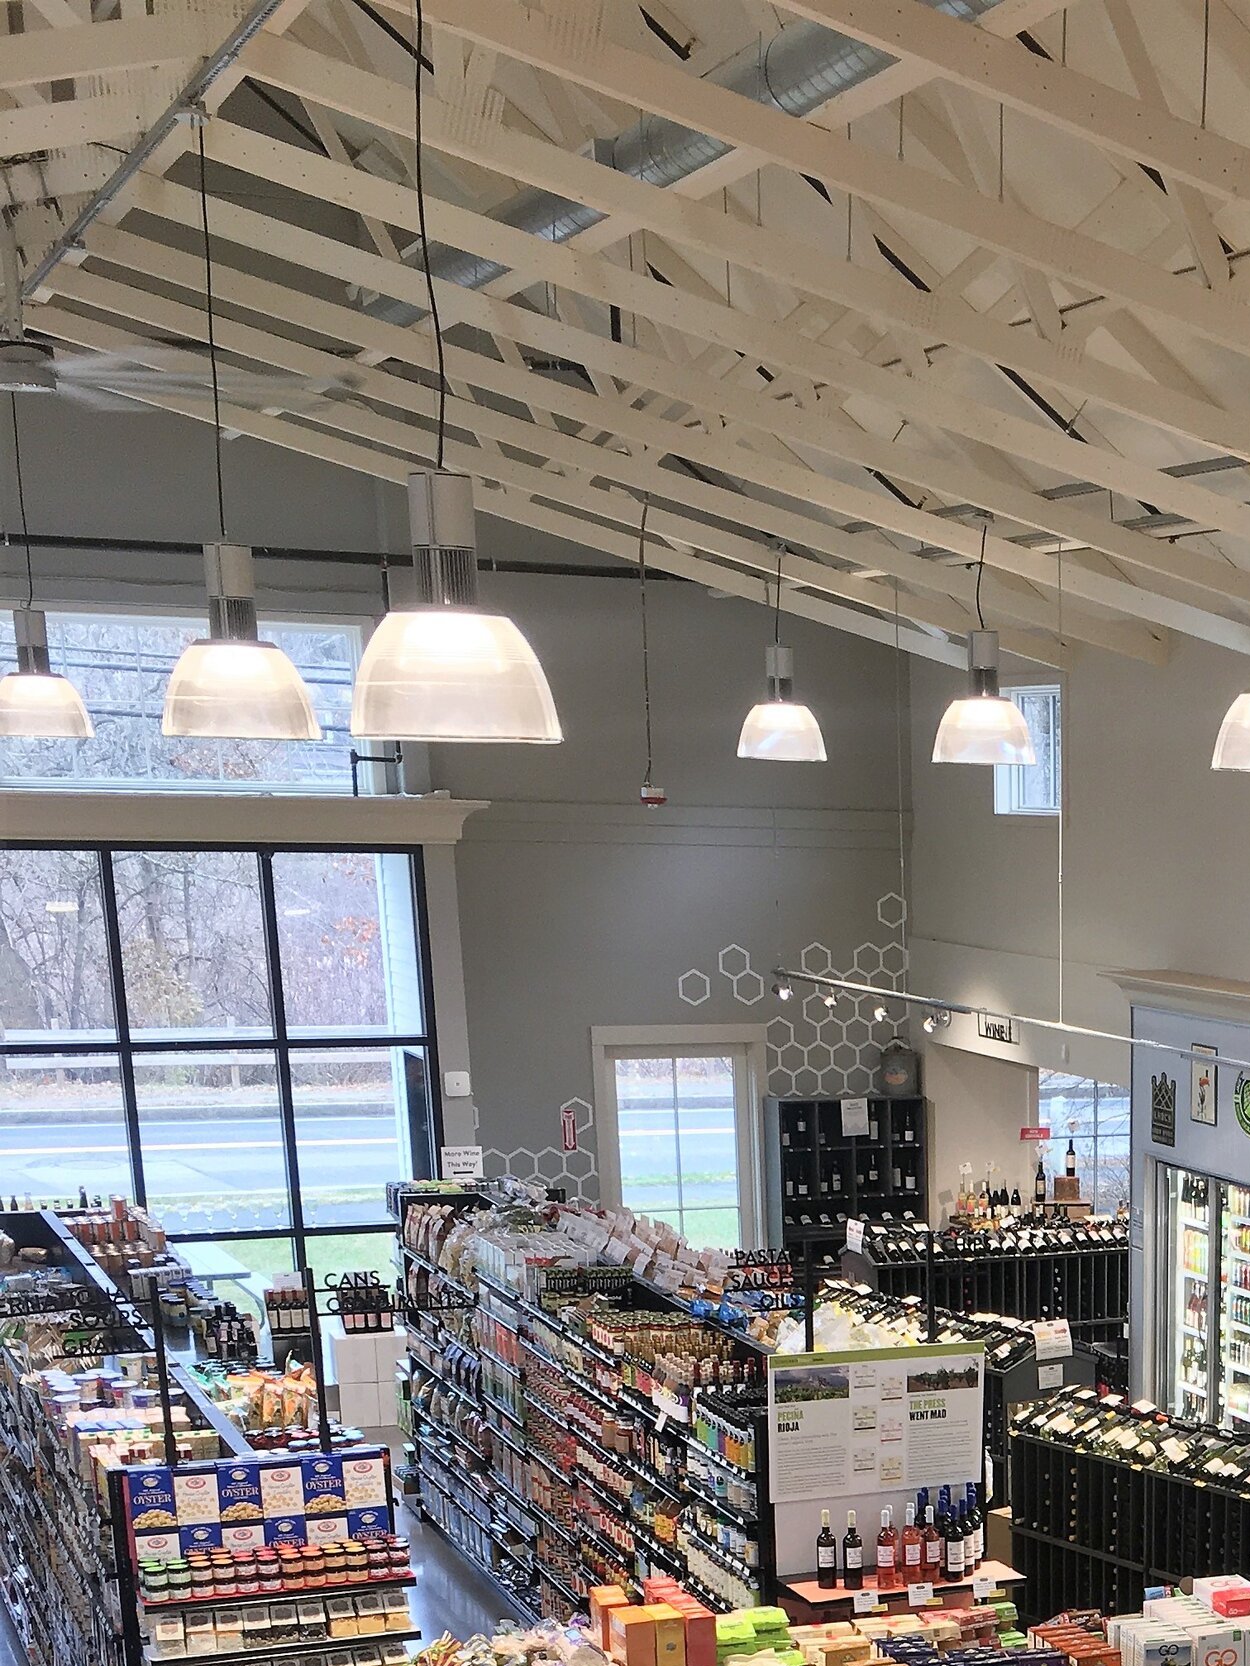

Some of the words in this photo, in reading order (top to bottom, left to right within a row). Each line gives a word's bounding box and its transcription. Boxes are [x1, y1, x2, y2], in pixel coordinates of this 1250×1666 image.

[324, 1270, 381, 1289] CANS
[761, 1293, 805, 1309] OILS
[910, 1400, 923, 1410] THE
[924, 1398, 946, 1409] PRESS
[909, 1411, 929, 1421] WENT
[930, 1409, 947, 1419] MAD
[778, 1422, 800, 1433] RIOJA
[305, 1479, 342, 1491] OYSTER
[221, 1486, 259, 1498] OYSTER
[133, 1493, 172, 1505] OYSTER
